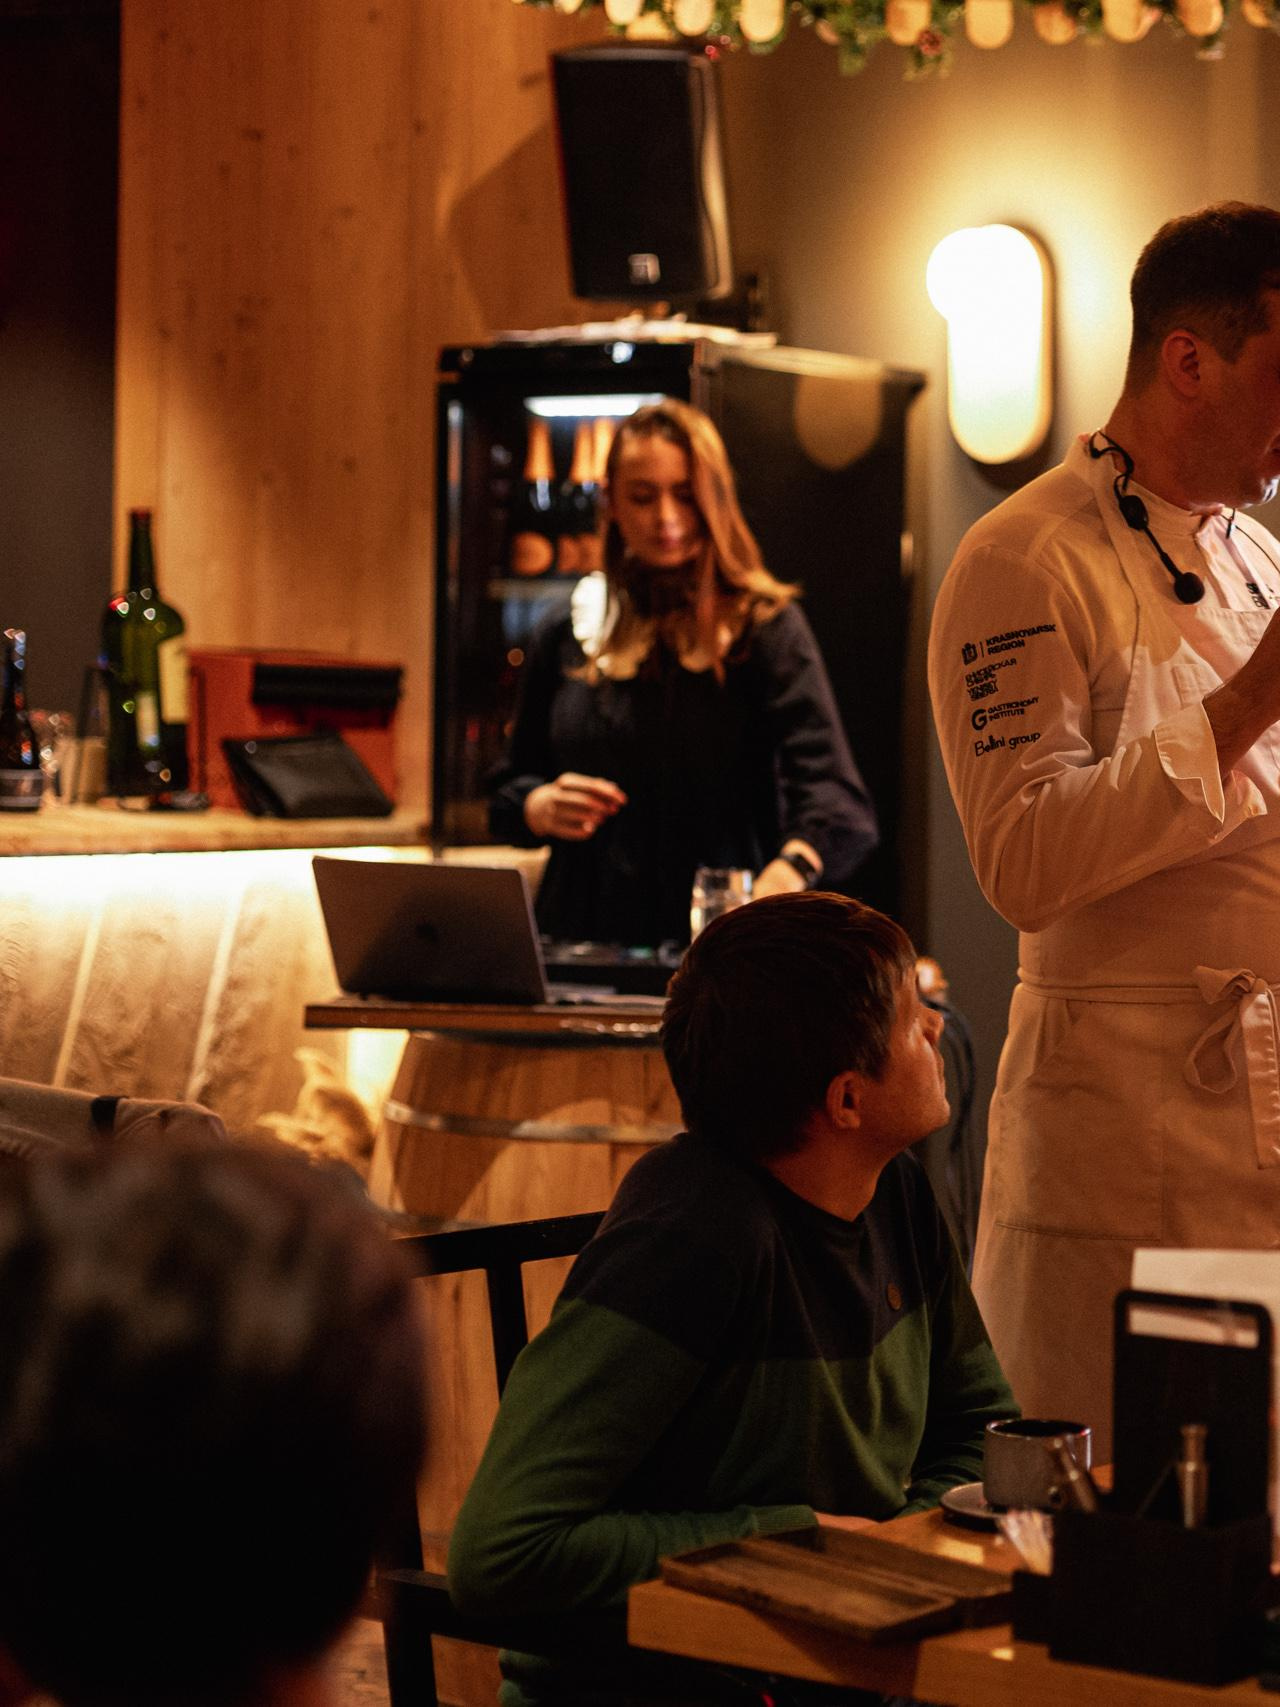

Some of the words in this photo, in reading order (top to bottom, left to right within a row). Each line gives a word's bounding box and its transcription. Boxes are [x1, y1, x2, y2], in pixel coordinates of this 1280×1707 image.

[986, 624, 1057, 646] KRASNOYARSK
[987, 639, 1025, 655] REGION
[988, 696, 1039, 714] GASTRONOMY
[989, 708, 1025, 721] INSTITUTE
[1008, 732, 1041, 750] group
